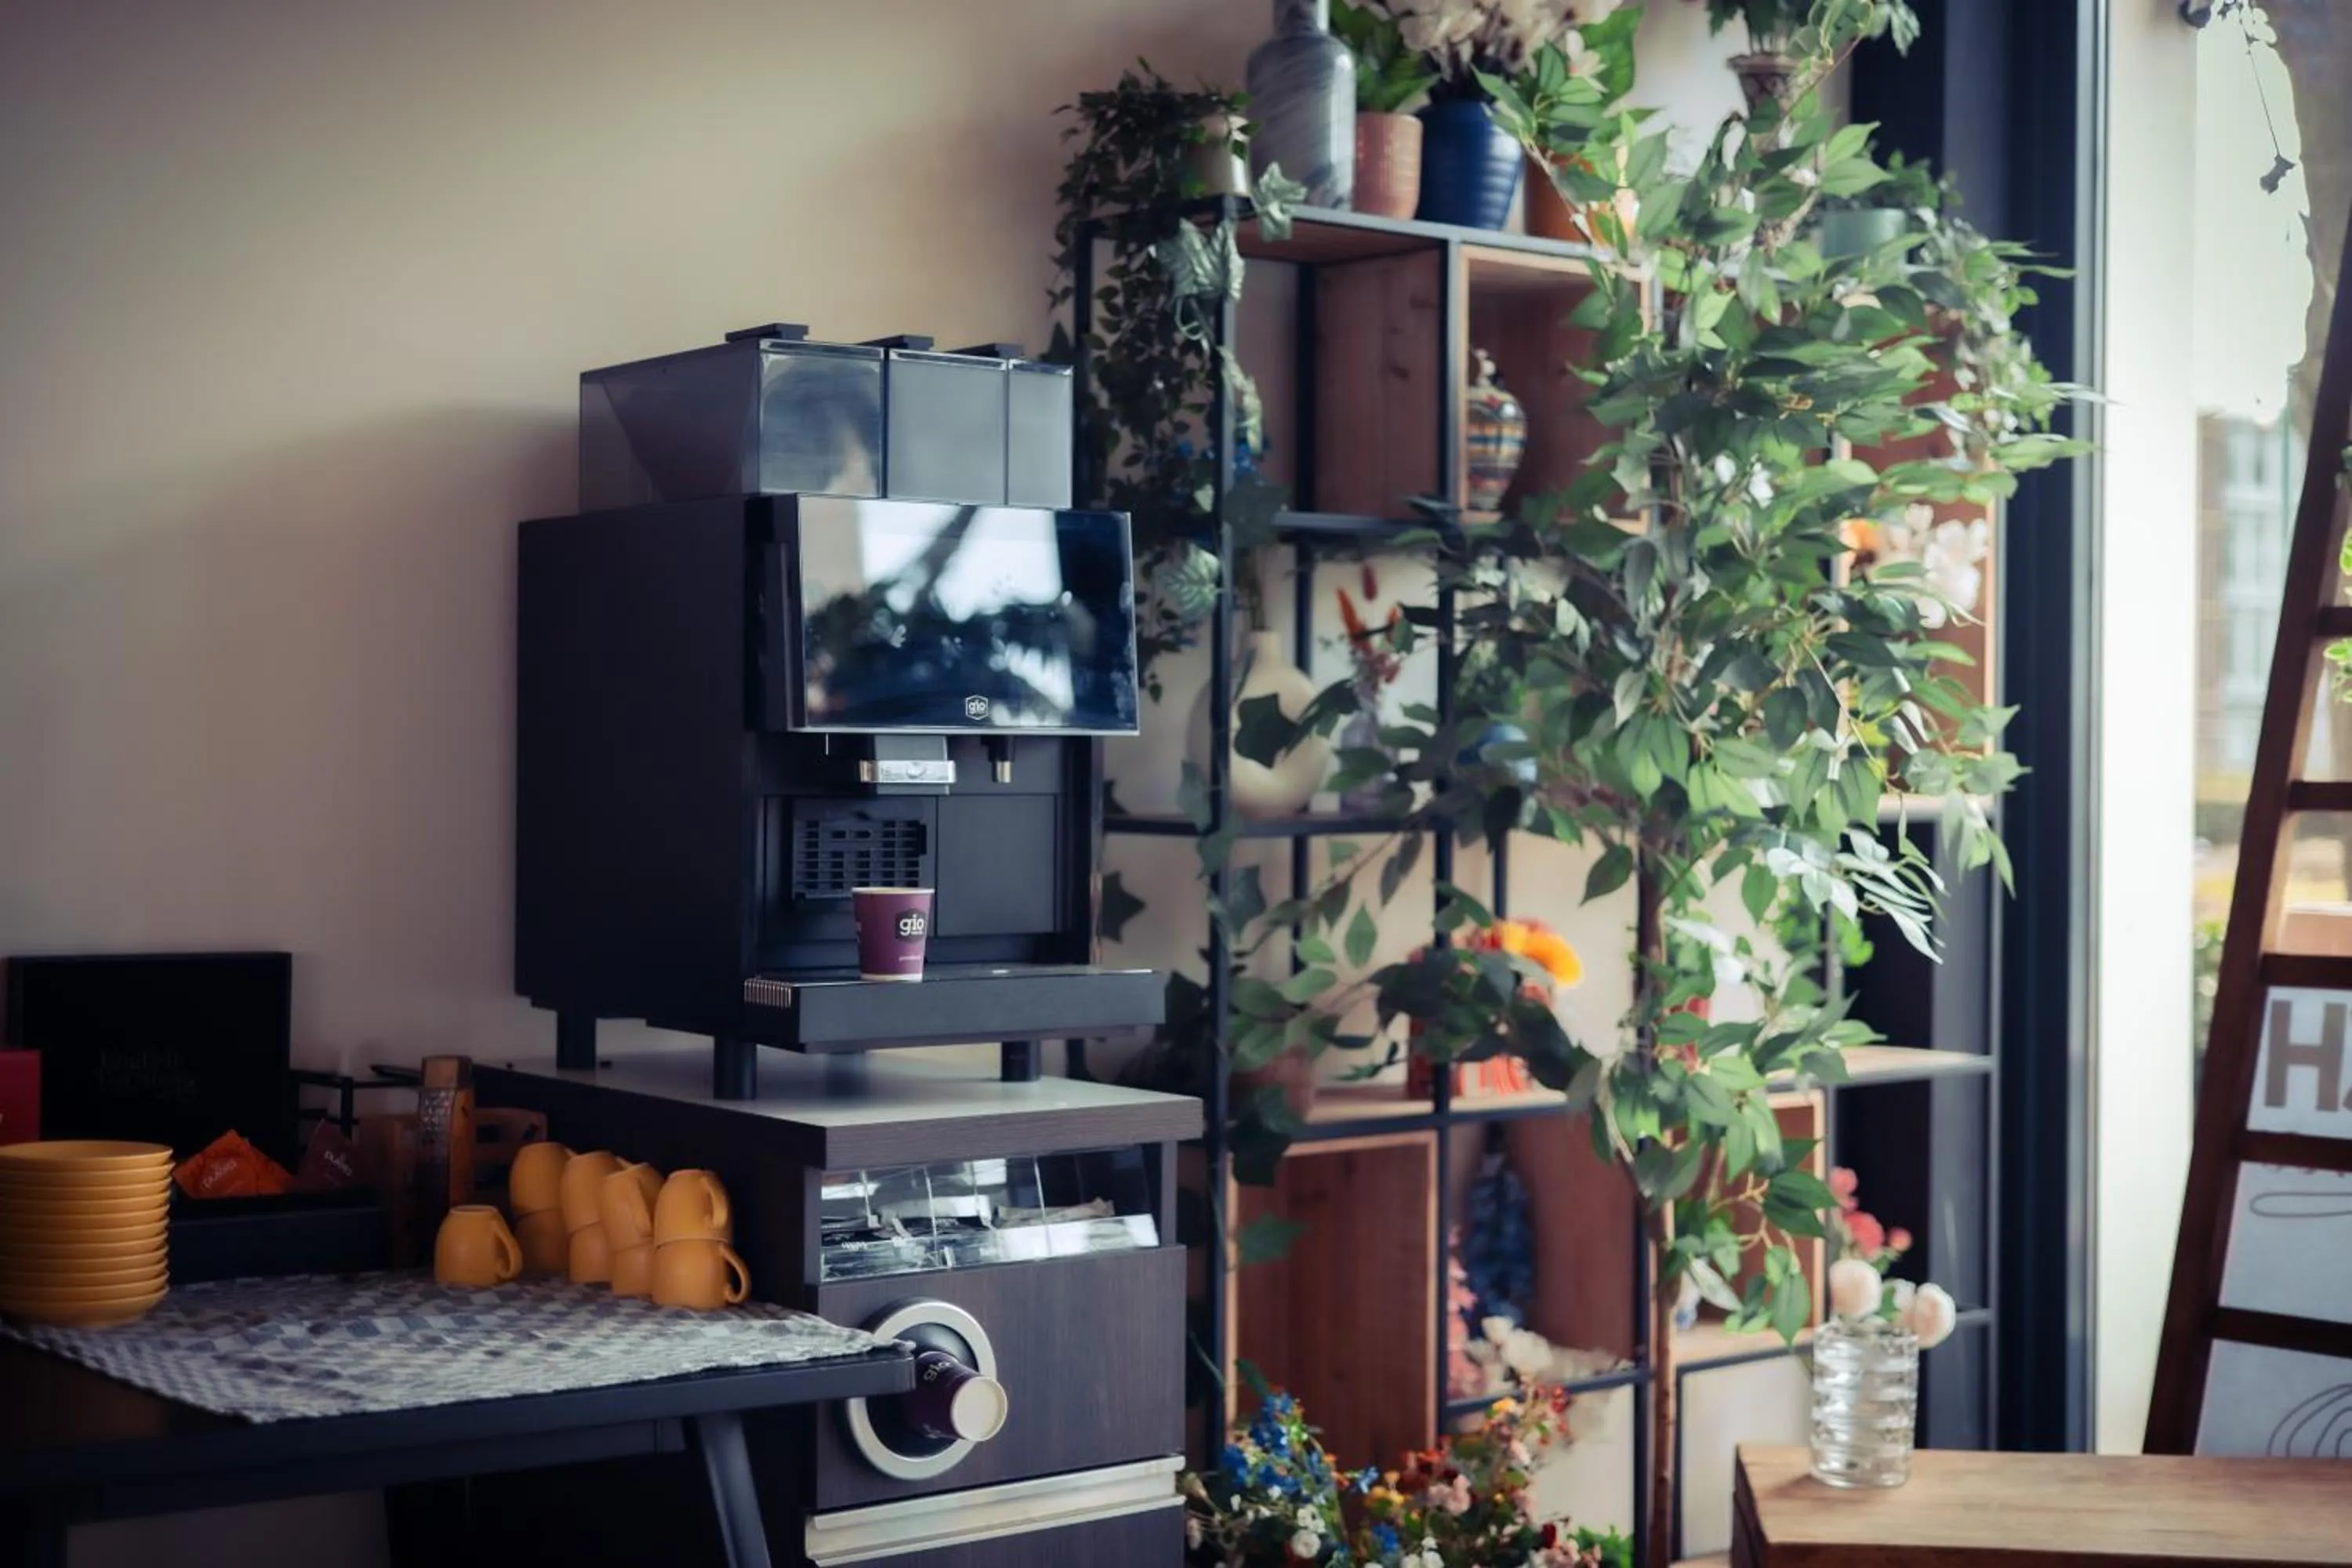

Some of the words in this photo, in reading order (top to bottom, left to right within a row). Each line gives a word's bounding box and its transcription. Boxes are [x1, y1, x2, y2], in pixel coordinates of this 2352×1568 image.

[969, 699, 985, 714] gio
[899, 913, 924, 936] gio
[2264, 1000, 2352, 1112] H
